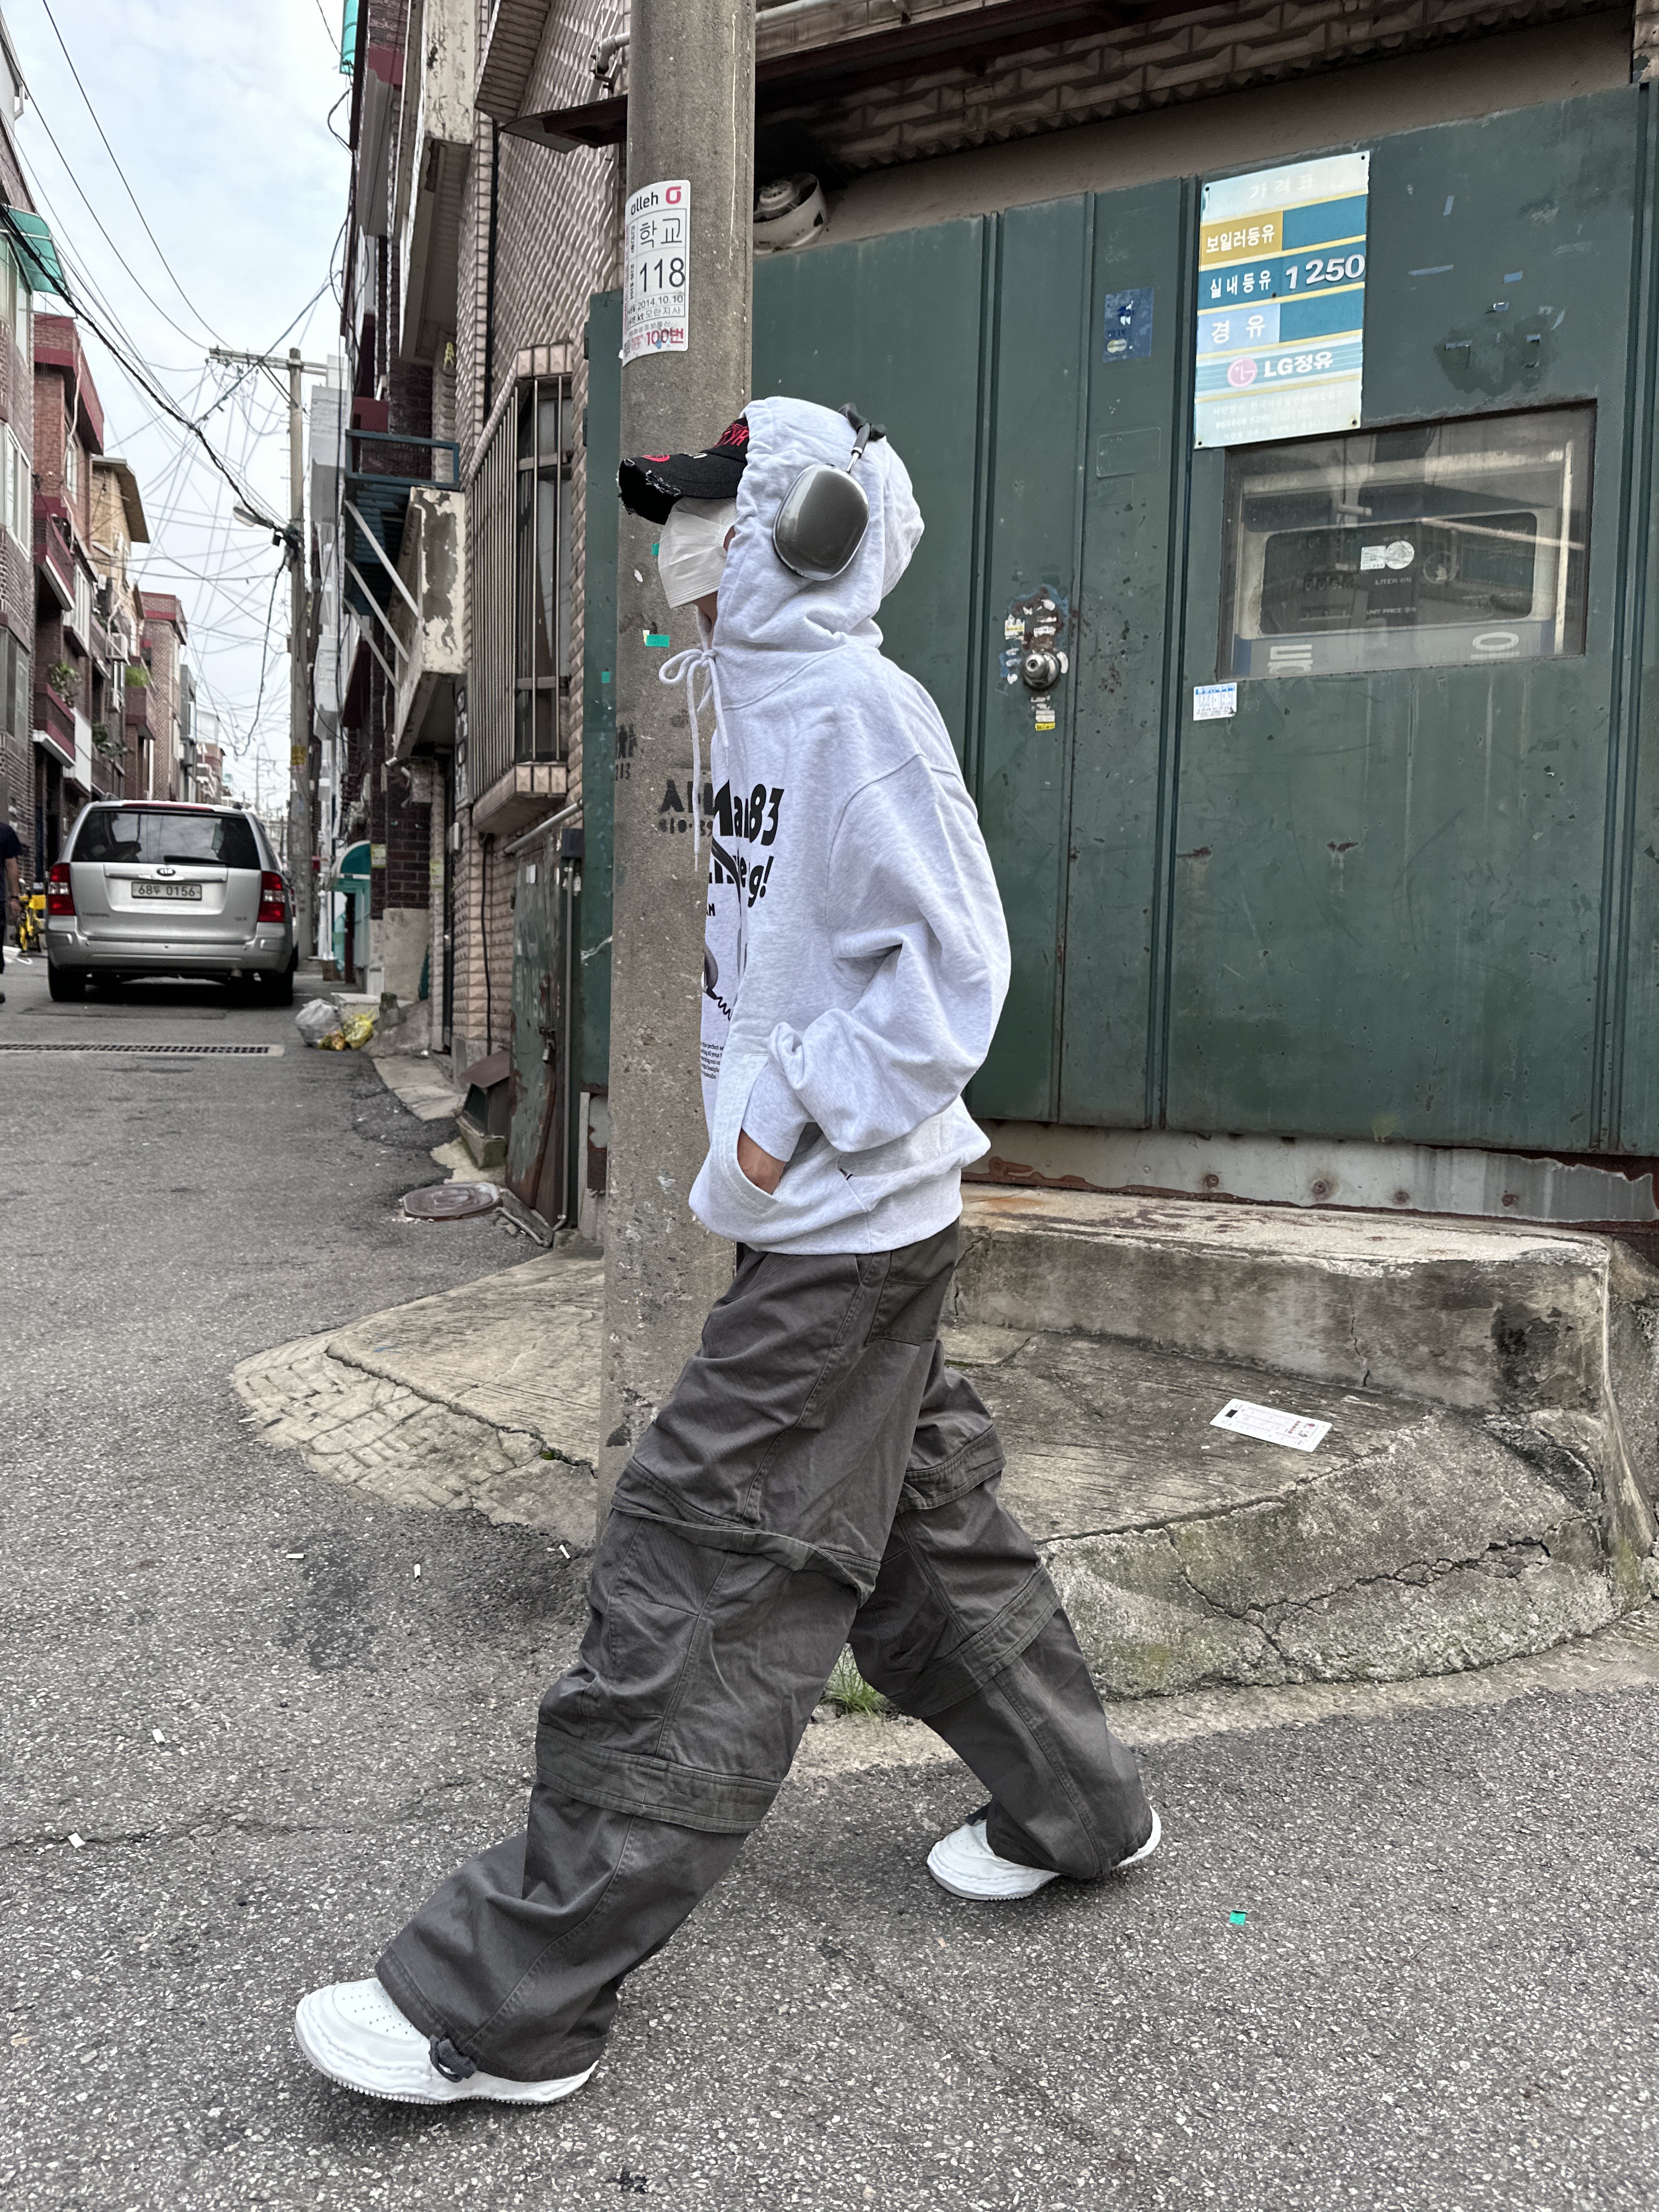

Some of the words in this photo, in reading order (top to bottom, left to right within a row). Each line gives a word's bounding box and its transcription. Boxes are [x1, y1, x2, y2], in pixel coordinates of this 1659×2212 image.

[630, 191, 658, 216] olleh
[639, 218, 682, 248] 학교
[1206, 224, 1276, 253] 보일러등유
[639, 257, 686, 292] 118
[1210, 269, 1272, 299] 실내등유
[637, 295, 684, 311] 2014.10.10
[637, 312, 644, 322] kt
[646, 328, 684, 346] 100번
[1263, 351, 1334, 378] LG정유
[166, 885, 195, 897] 0156
